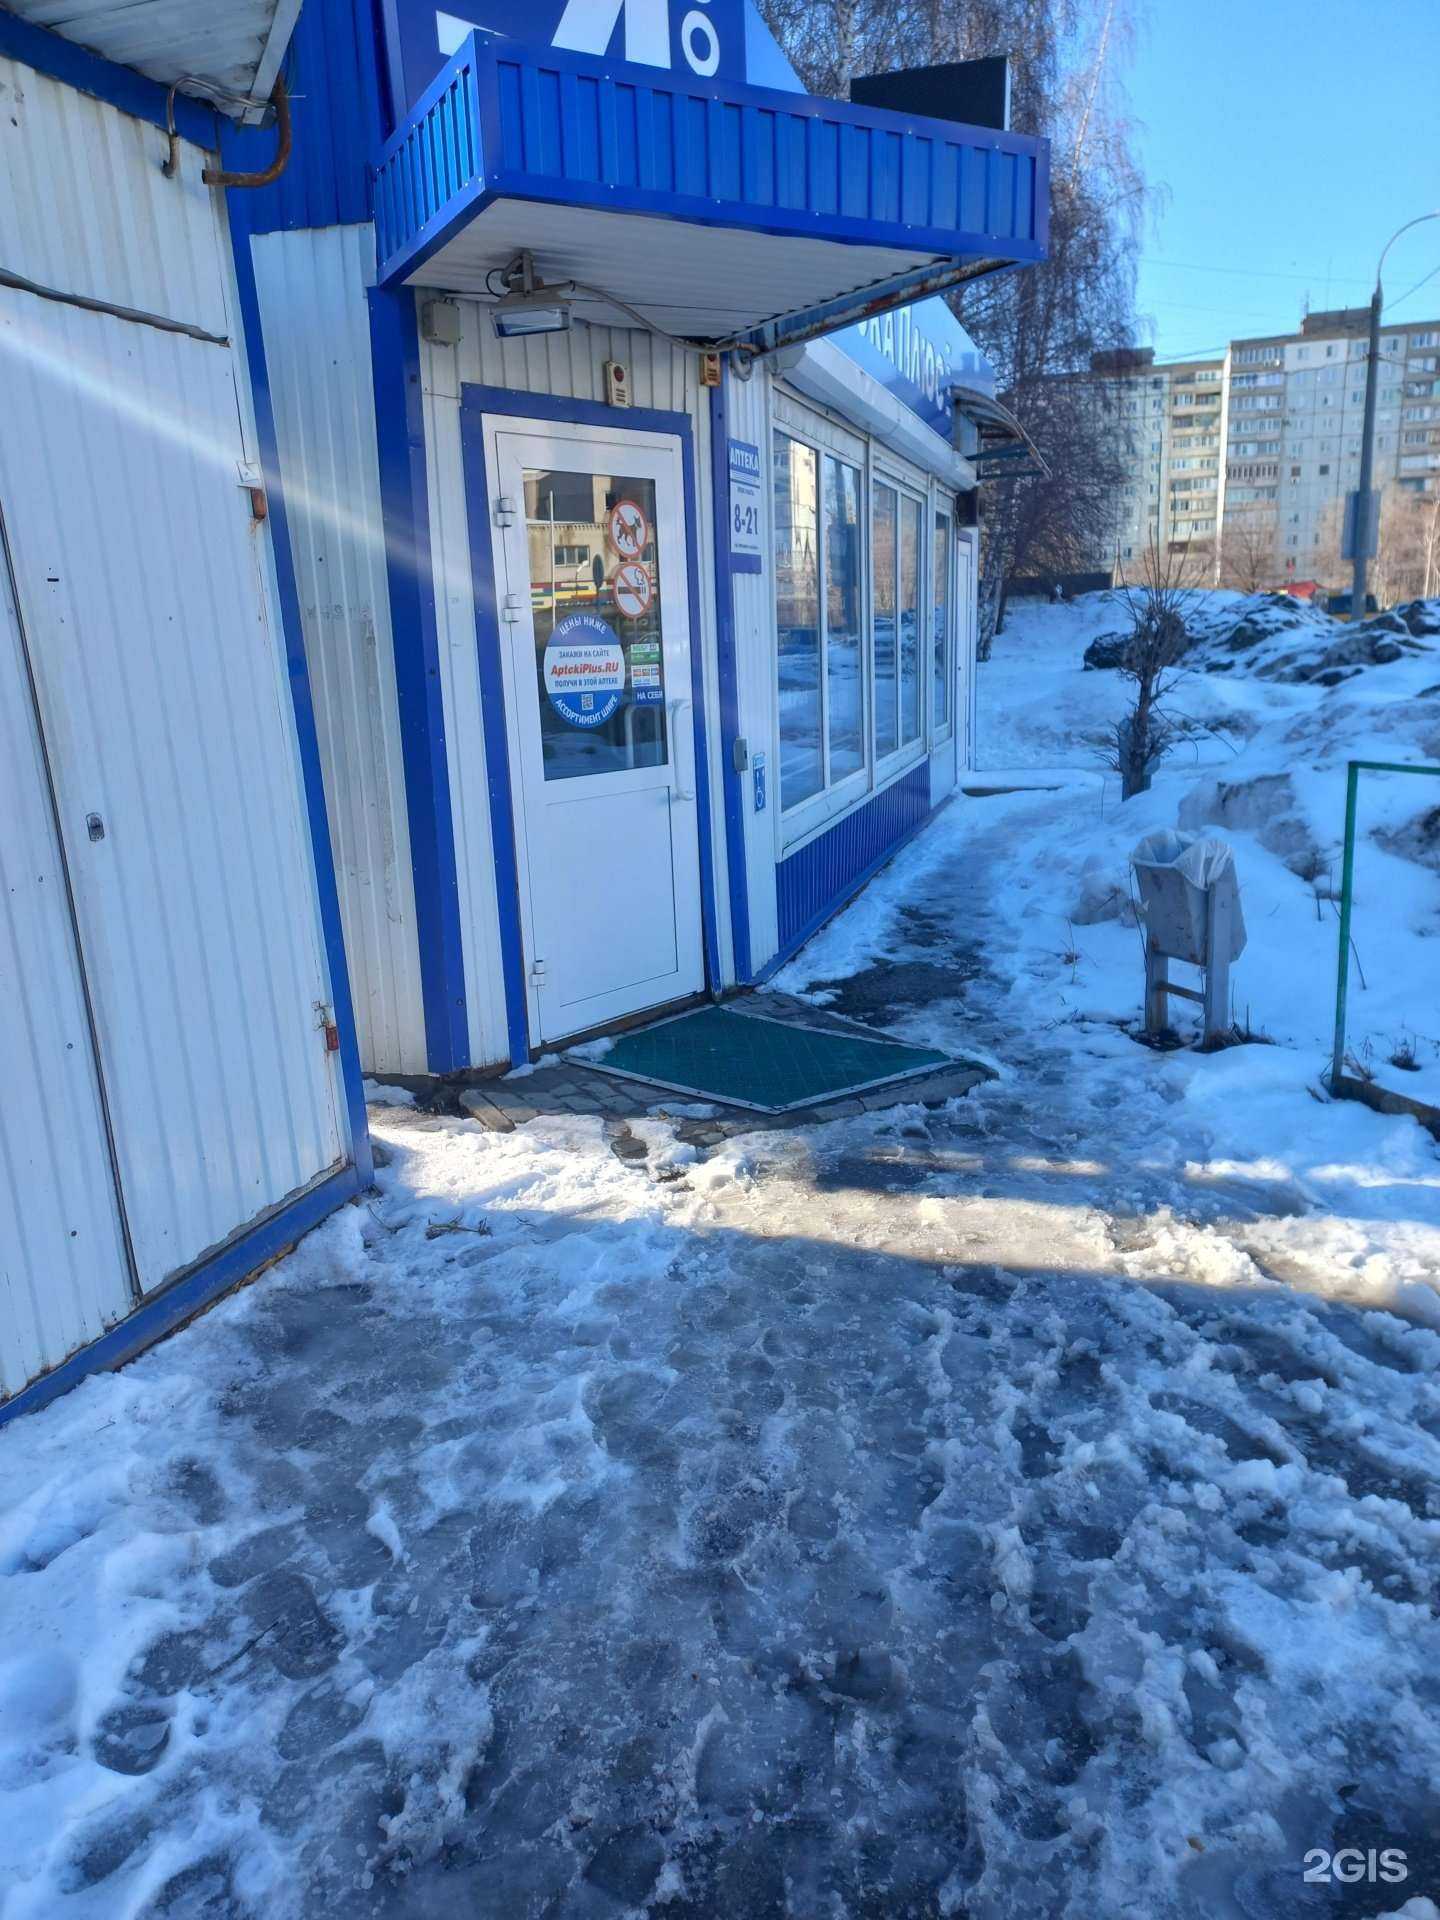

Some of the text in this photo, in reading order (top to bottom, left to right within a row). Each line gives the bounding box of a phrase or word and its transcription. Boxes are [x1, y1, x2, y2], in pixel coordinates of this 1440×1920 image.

[731, 447, 760, 470] АПТЕКА
[734, 504, 759, 535] 8-21
[559, 616, 608, 634] ЦЕНЫ НИЖЕ
[593, 647, 609, 657] САЙТЕ
[551, 662, 619, 677] AptekiPlus.RU
[637, 691, 647, 701] НА
[555, 694, 618, 725] АССОРТИМЕНТ ШИРЕ
